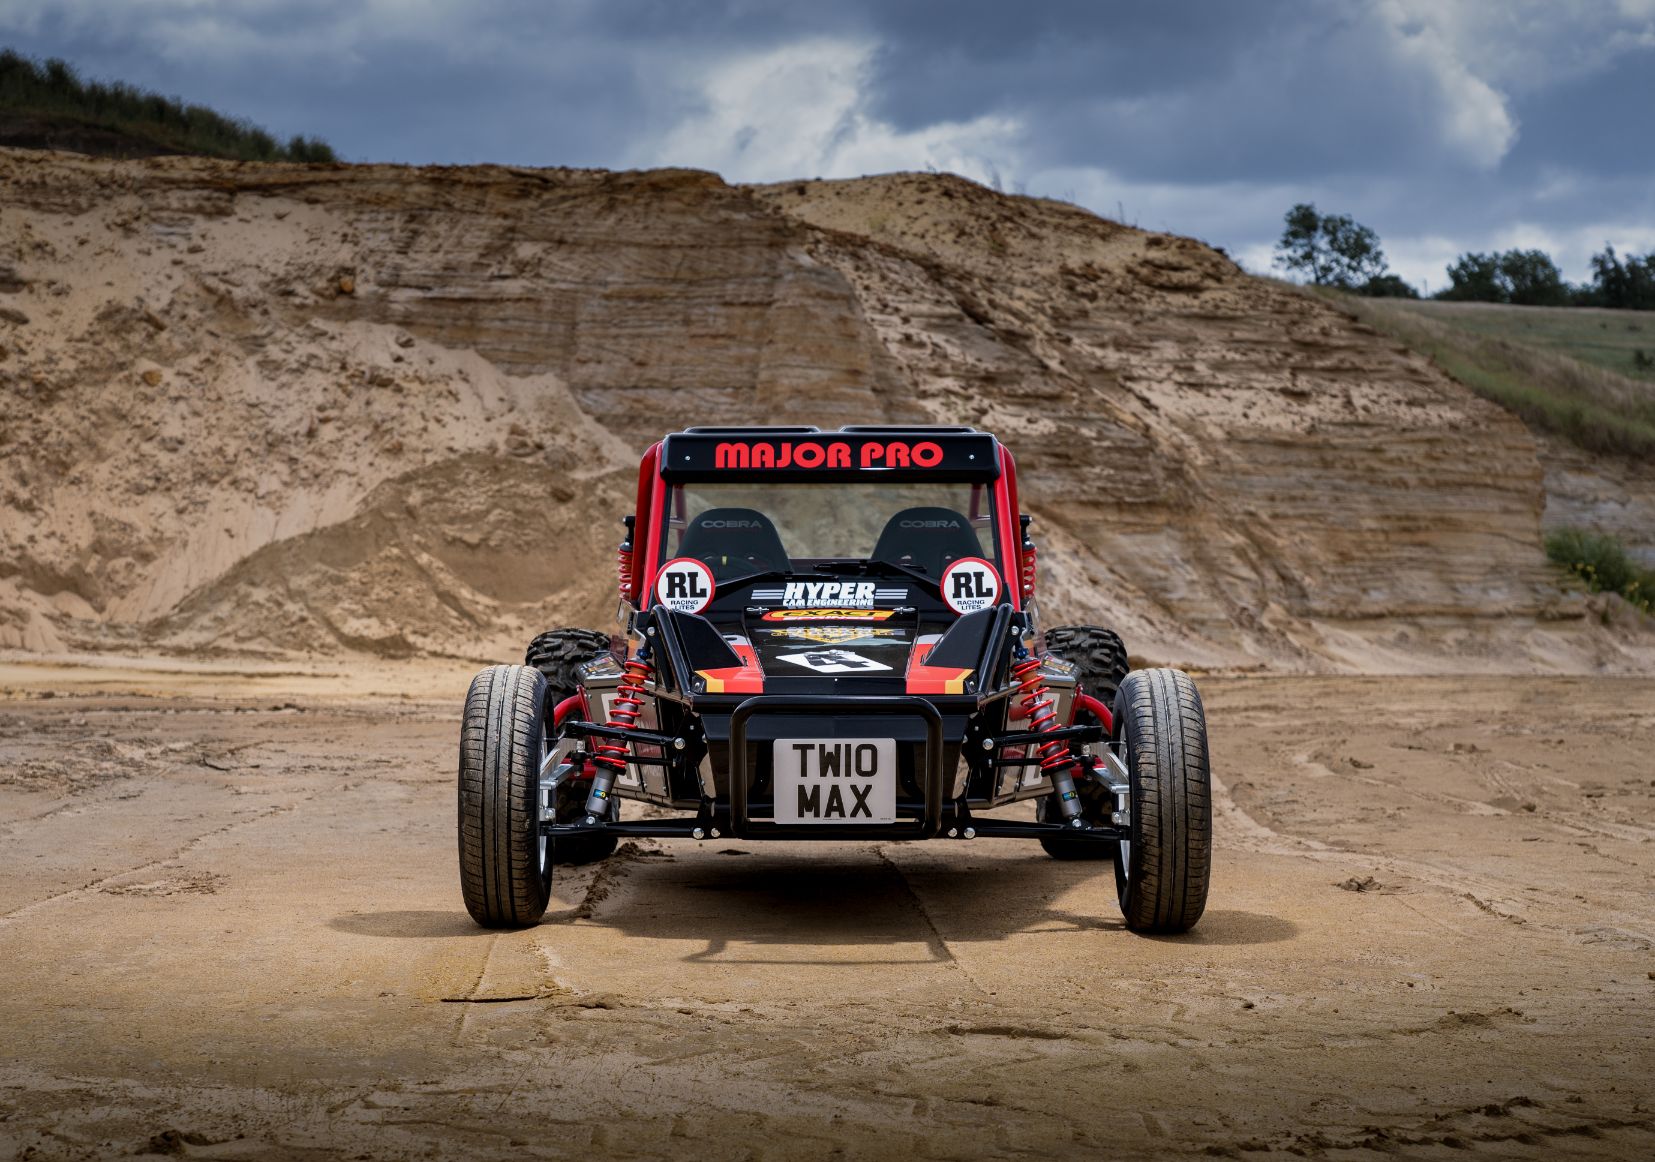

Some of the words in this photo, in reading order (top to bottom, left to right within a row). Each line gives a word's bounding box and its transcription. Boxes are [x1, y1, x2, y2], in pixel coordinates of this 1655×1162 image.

[715, 442, 851, 469] MAJOR
[860, 441, 944, 468] PRO
[701, 519, 762, 529] COBRA
[900, 519, 960, 529] COBRA
[666, 572, 707, 598] RL
[783, 582, 876, 599] HYPER
[952, 572, 993, 599] RL
[797, 784, 873, 818] MAX
